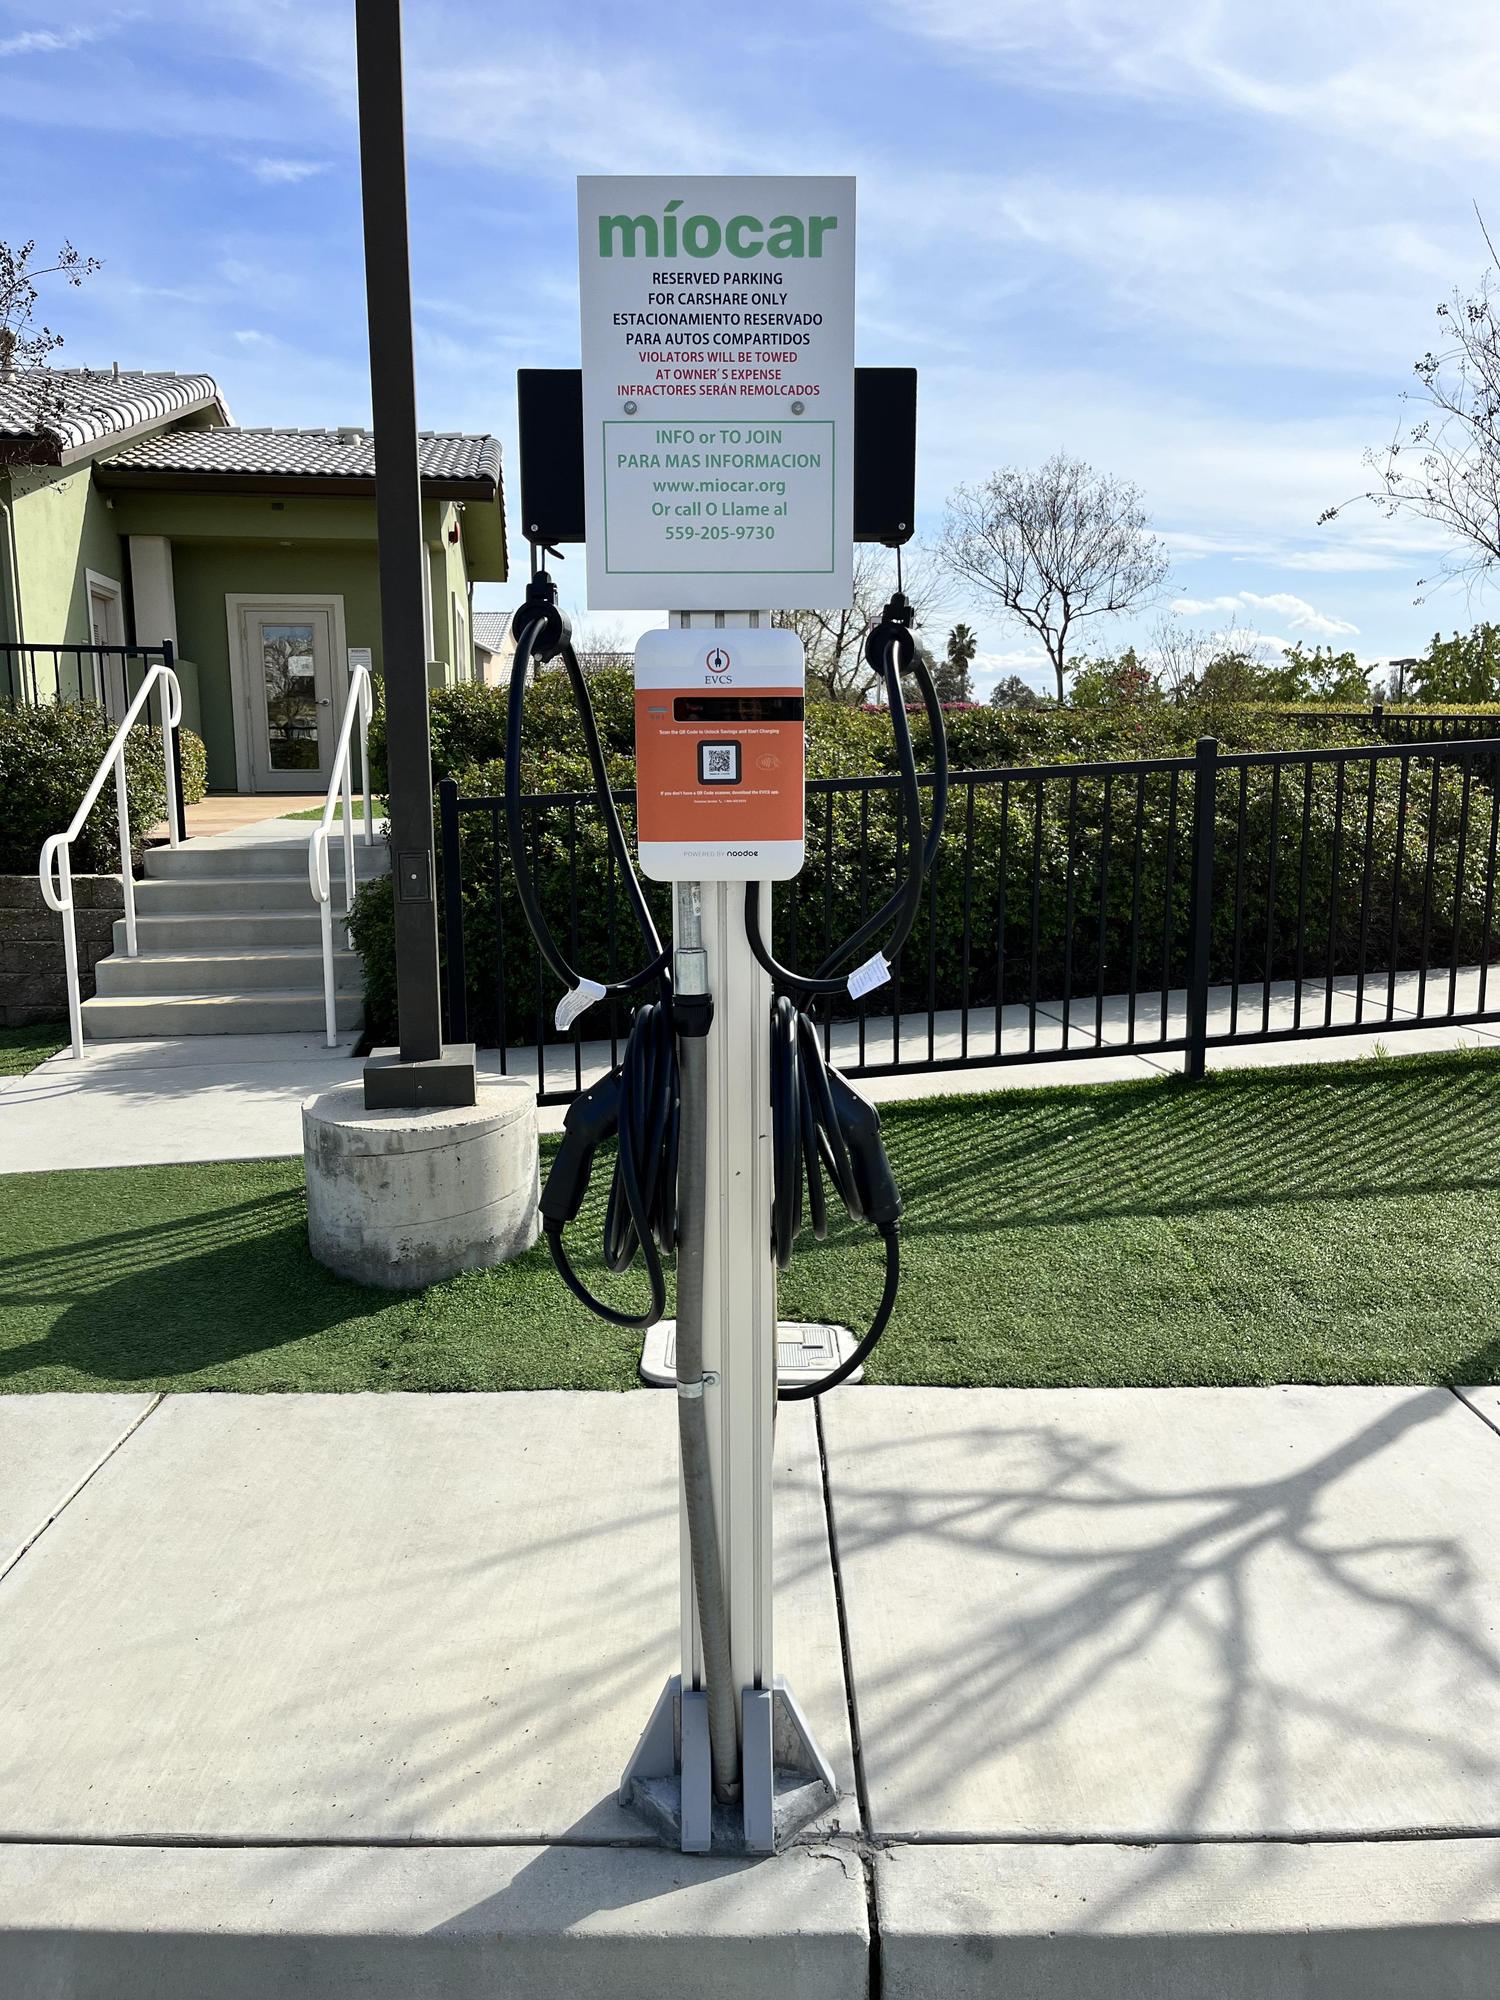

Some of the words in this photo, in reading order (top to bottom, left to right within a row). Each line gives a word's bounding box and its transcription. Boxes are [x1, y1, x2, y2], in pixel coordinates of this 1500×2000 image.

[598, 200, 838, 259] míocar
[652, 272, 720, 285] RESERVED
[723, 272, 783, 285] PARKING
[648, 293, 675, 306] FOR
[677, 293, 748, 306] CARSHARE
[751, 293, 788, 306] ONLY
[613, 313, 741, 326] ESTACIONAMIENTO
[744, 313, 823, 326] RESERVADO
[626, 333, 662, 346] PARA
[665, 333, 710, 346] AUTOS
[713, 333, 810, 346] COMPARTIDOS
[639, 351, 704, 363] VIOLATORS
[706, 351, 735, 363] WILL
[738, 351, 752, 363] BE
[754, 351, 798, 363] TOWED
[656, 369, 670, 380] AT
[731, 369, 782, 380] EXPENSE
[617, 385, 697, 396] INFRACTORES
[699, 383, 737, 396] SERÁN
[740, 385, 820, 396] REMOLCADOS
[656, 430, 695, 444] INFO
[699, 433, 716, 444] or
[719, 430, 741, 444] TO
[745, 430, 782, 444] JOIN
[617, 455, 661, 468] PARA
[665, 455, 701, 468] MAS
[706, 454, 821, 468] INFORMACION
[653, 479, 786, 495] www.miocar.org
[652, 502, 671, 516] Or
[675, 502, 701, 516] call
[706, 503, 718, 516] O
[722, 502, 770, 516] Llame
[774, 502, 787, 516] al
[665, 527, 775, 540] 559-205-9730
[704, 675, 733, 685] EVCS
